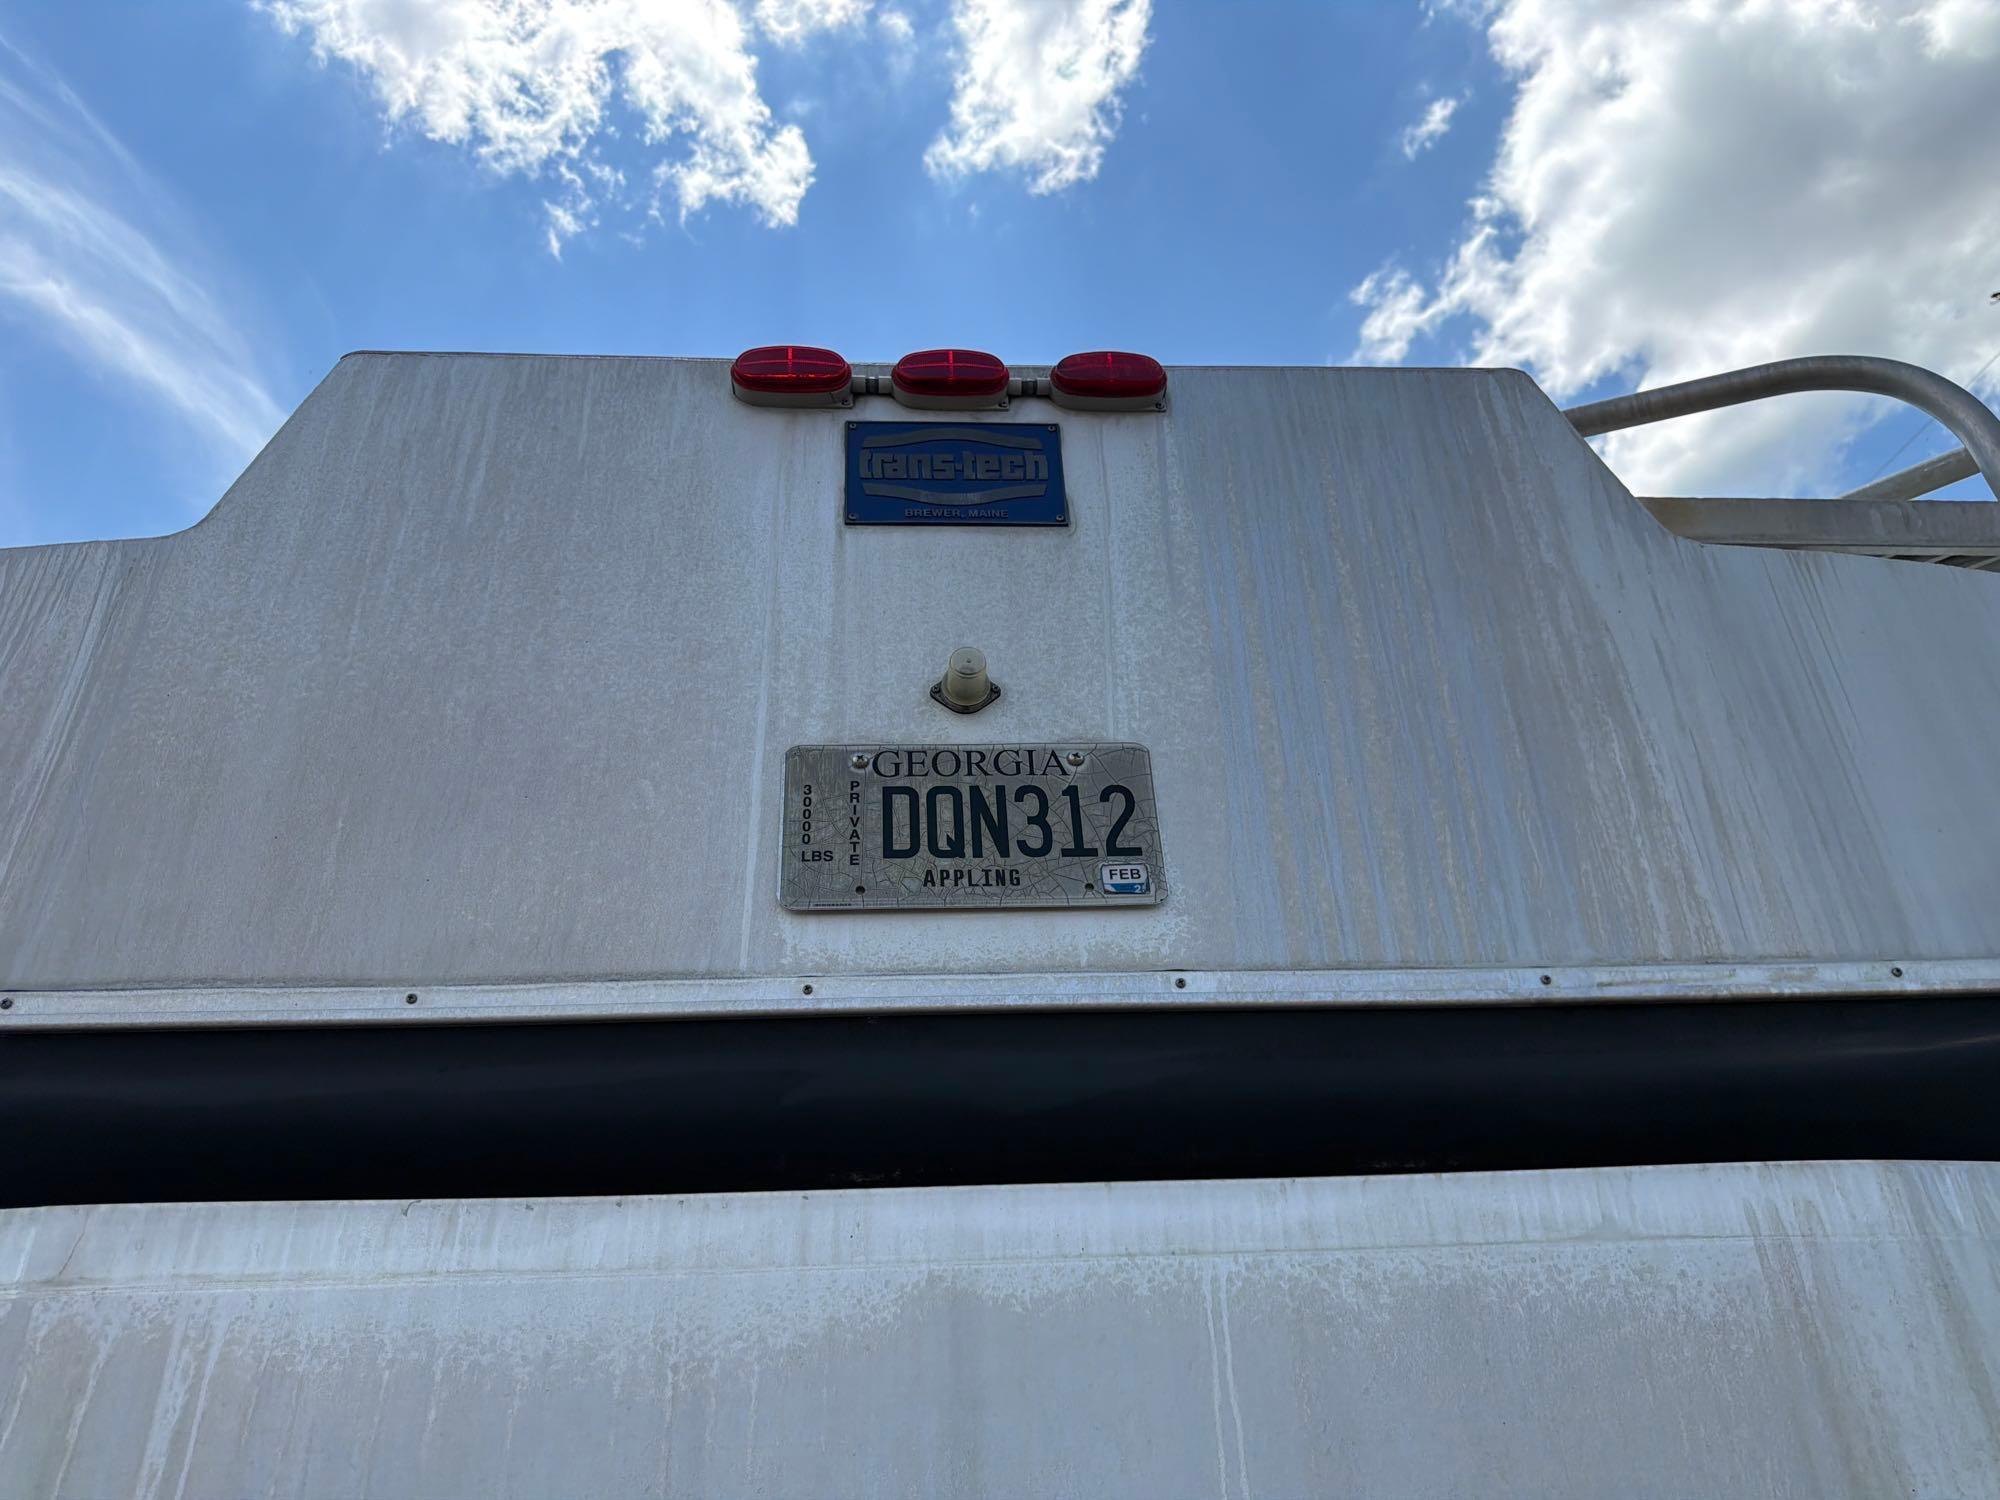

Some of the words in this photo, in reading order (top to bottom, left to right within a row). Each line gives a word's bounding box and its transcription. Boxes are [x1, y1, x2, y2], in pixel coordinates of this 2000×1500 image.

[968, 508, 1009, 518] MAINE
[872, 749, 1070, 777] GEORGIA
[849, 780, 860, 866] PRIVATE
[881, 784, 1143, 859] DQN312
[801, 850, 834, 863] LBS
[922, 868, 1021, 888] APPLING
[1109, 868, 1142, 880] FEB
